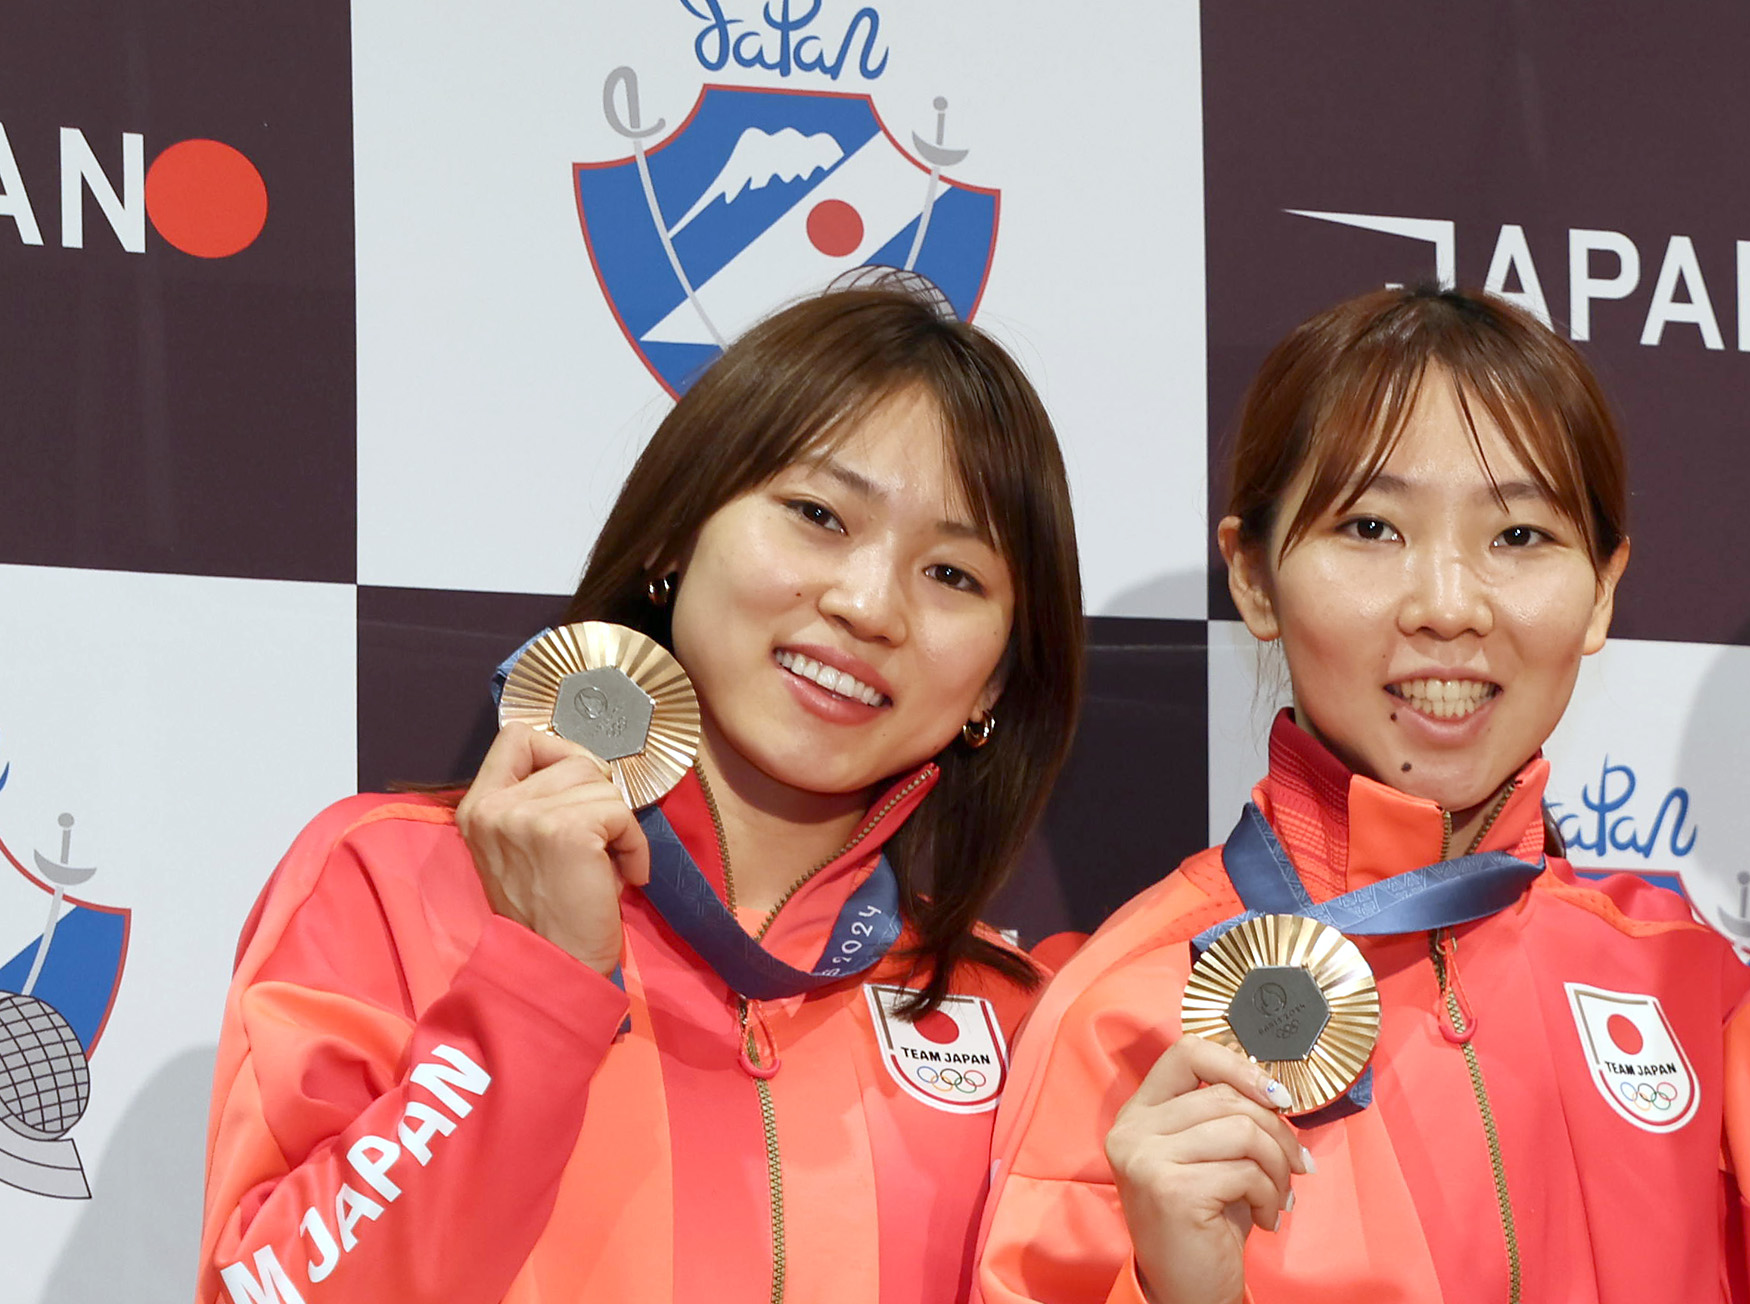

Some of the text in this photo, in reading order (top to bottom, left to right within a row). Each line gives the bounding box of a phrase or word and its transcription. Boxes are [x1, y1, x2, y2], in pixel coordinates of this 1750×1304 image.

[900, 1046, 991, 1065] TEAM JAPAN
[1604, 1060, 1678, 1076] TEAM JAPAN
[299, 1044, 492, 1283] JAPAN
